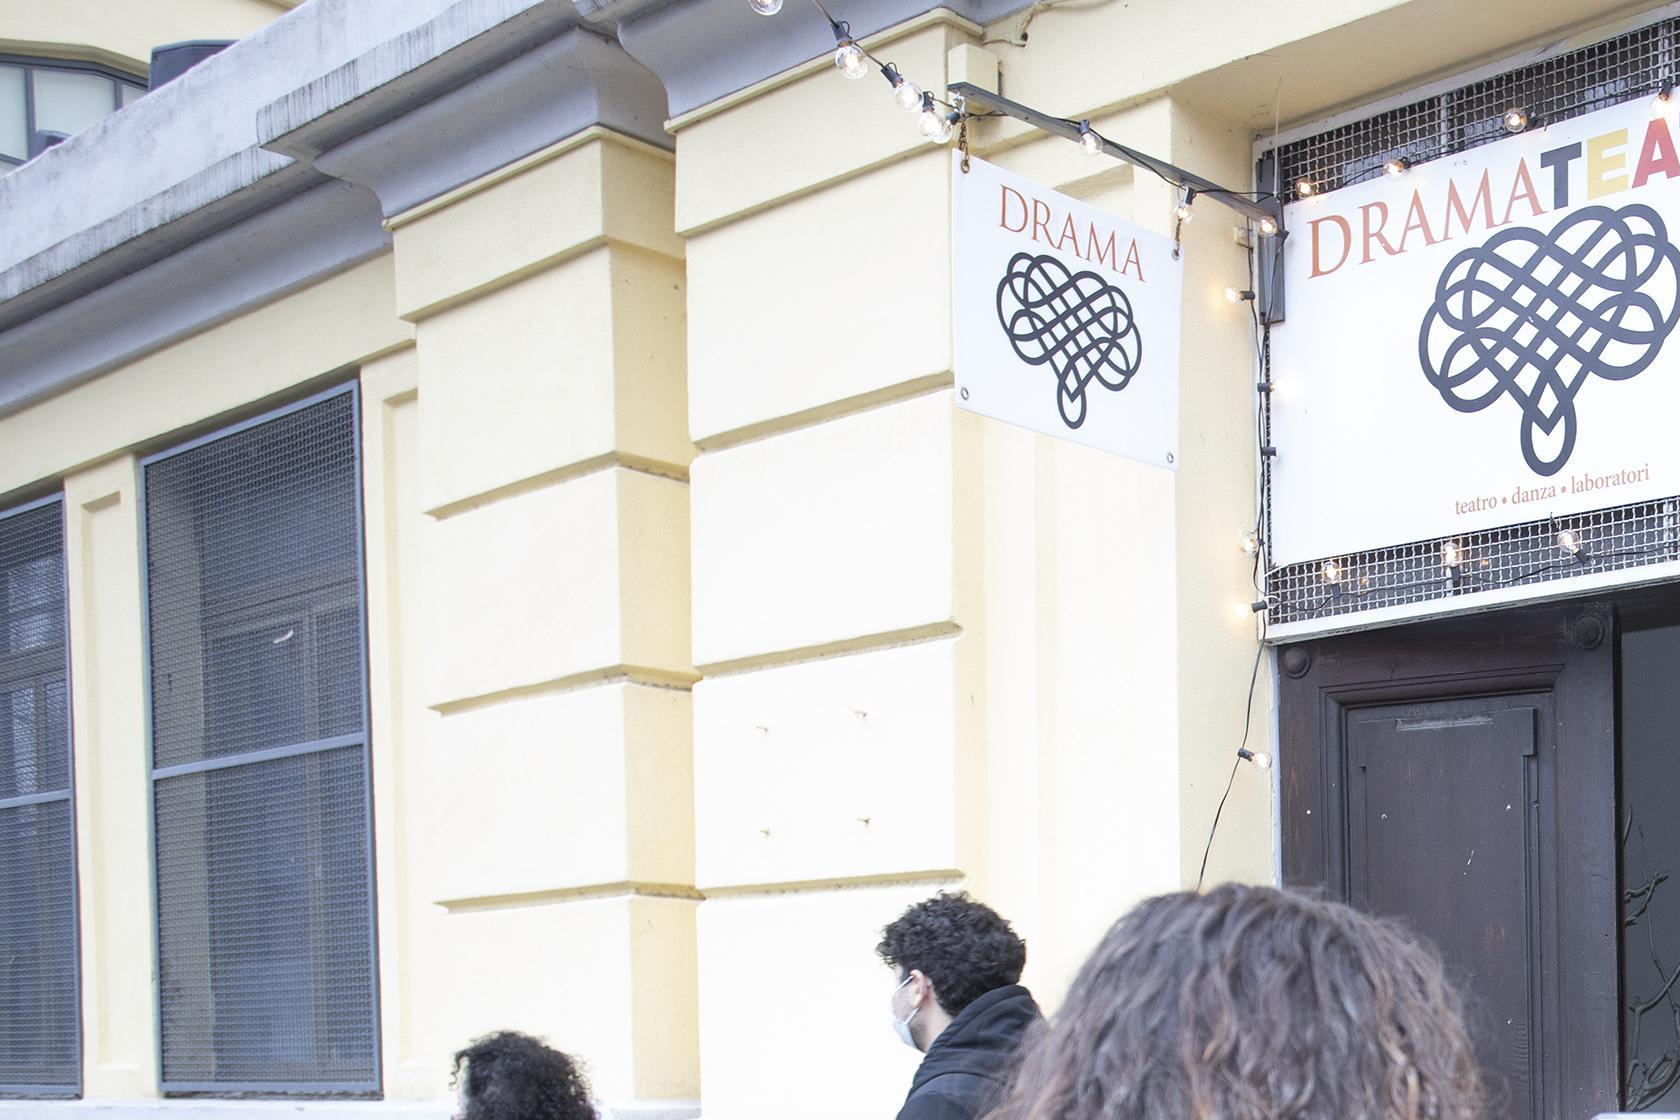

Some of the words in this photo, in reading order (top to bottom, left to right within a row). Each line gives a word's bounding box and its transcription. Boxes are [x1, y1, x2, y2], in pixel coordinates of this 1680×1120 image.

[999, 184, 1147, 283] DRAMA
[1454, 494, 1498, 515] teatro
[1511, 486, 1556, 505] danza
[1571, 463, 1650, 494] laboratori
